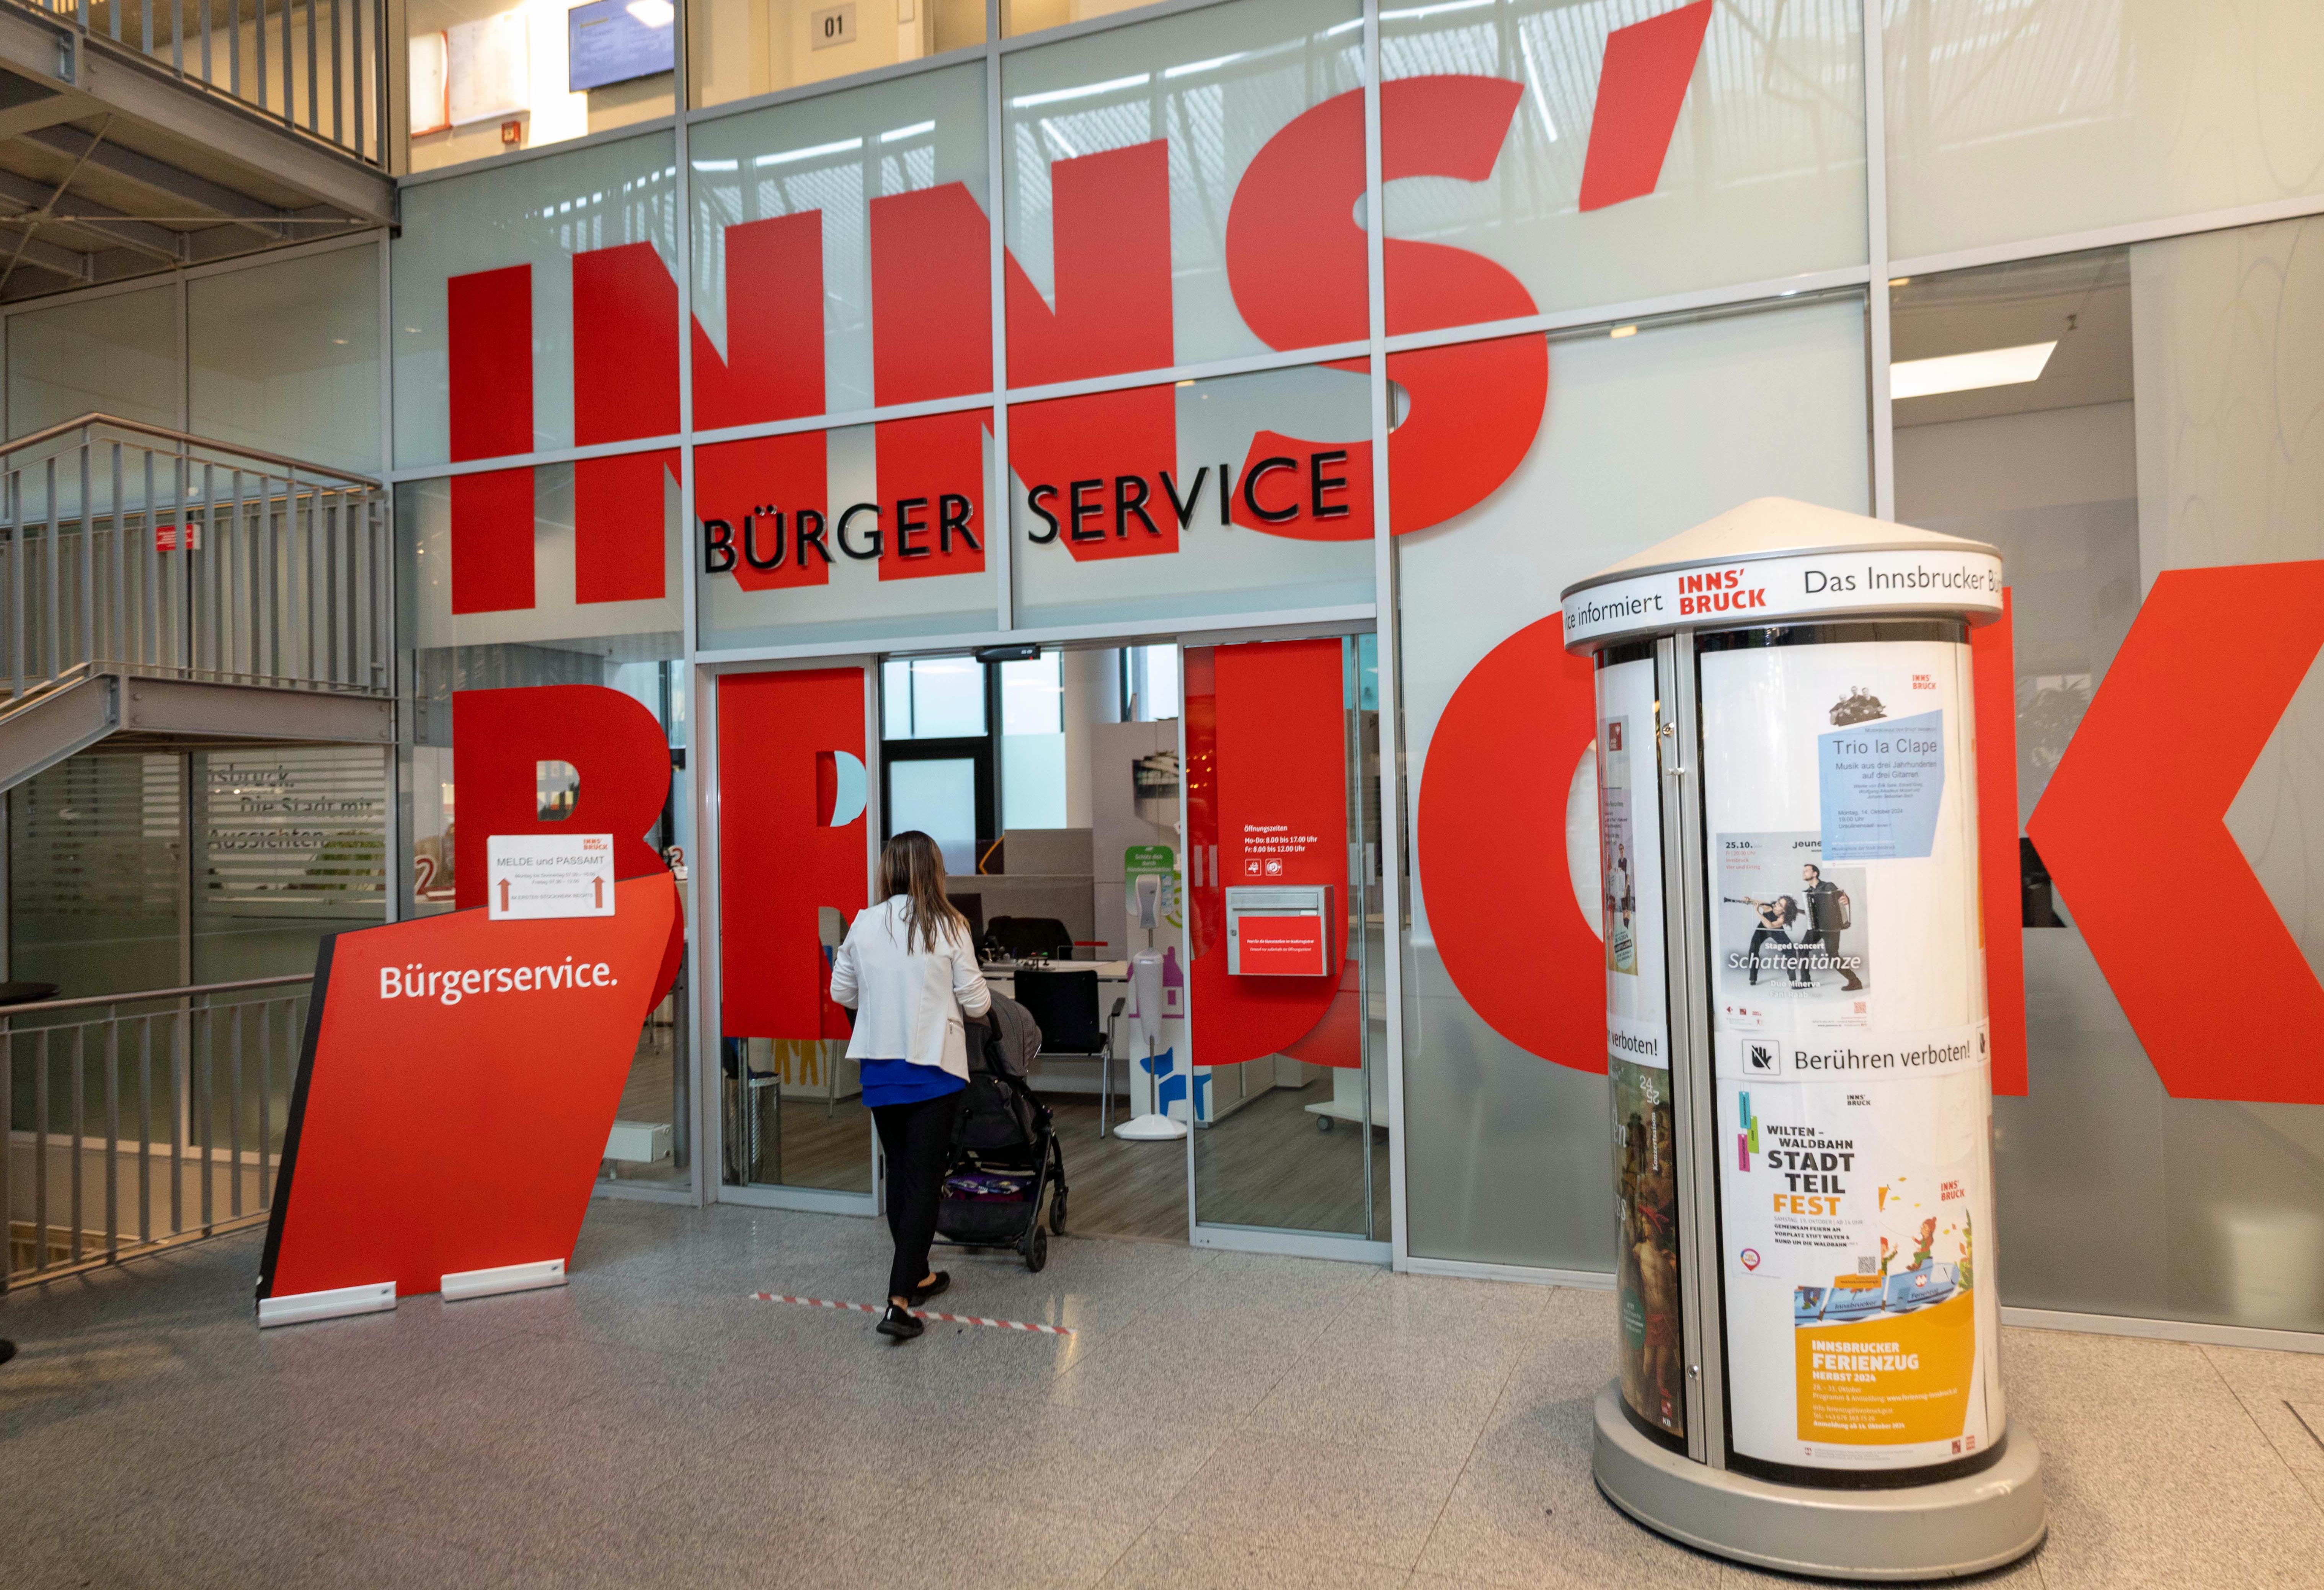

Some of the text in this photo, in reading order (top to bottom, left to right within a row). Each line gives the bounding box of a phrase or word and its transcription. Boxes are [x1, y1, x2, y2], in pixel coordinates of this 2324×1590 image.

[824, 15, 843, 38] 01
[704, 450, 1350, 573] BÜRGER SERVICE
[1678, 568, 1745, 595] INNS'
[1805, 570, 1856, 594] Das
[1869, 565, 1985, 591] Innsbrucker
[1578, 593, 1663, 626] informiert
[1679, 588, 1766, 615] BRUCK
[1833, 738, 1937, 756] Trio la Clape
[1244, 824, 1288, 833] Öffnungszeiten
[497, 856, 605, 867] MELDE und PASSAMT
[1765, 942, 1792, 951] Staged
[1728, 953, 1861, 970] Schattentänze
[380, 955, 618, 1006] Bürgerservice.
[1611, 1030, 1658, 1056] verboten!
[1795, 1040, 1971, 1070] Berühren verboten!
[1639, 1075, 1653, 1092] 24
[1767, 1125, 1815, 1136] WILTEN
[1779, 1138, 1853, 1149] WALDBAHN
[1768, 1150, 1855, 1172] STADT
[1784, 1173, 1846, 1194] TEIL
[1941, 1188, 1965, 1201] BRUCK
[1773, 1193, 1841, 1216] FEST
[1812, 1339, 1900, 1353] INNSBRUCKER
[1812, 1352, 1919, 1371] FERIENZUG
[1812, 1371, 1877, 1383] HERBST 2024
[1813, 1420, 1849, 1430] Anmeldung
